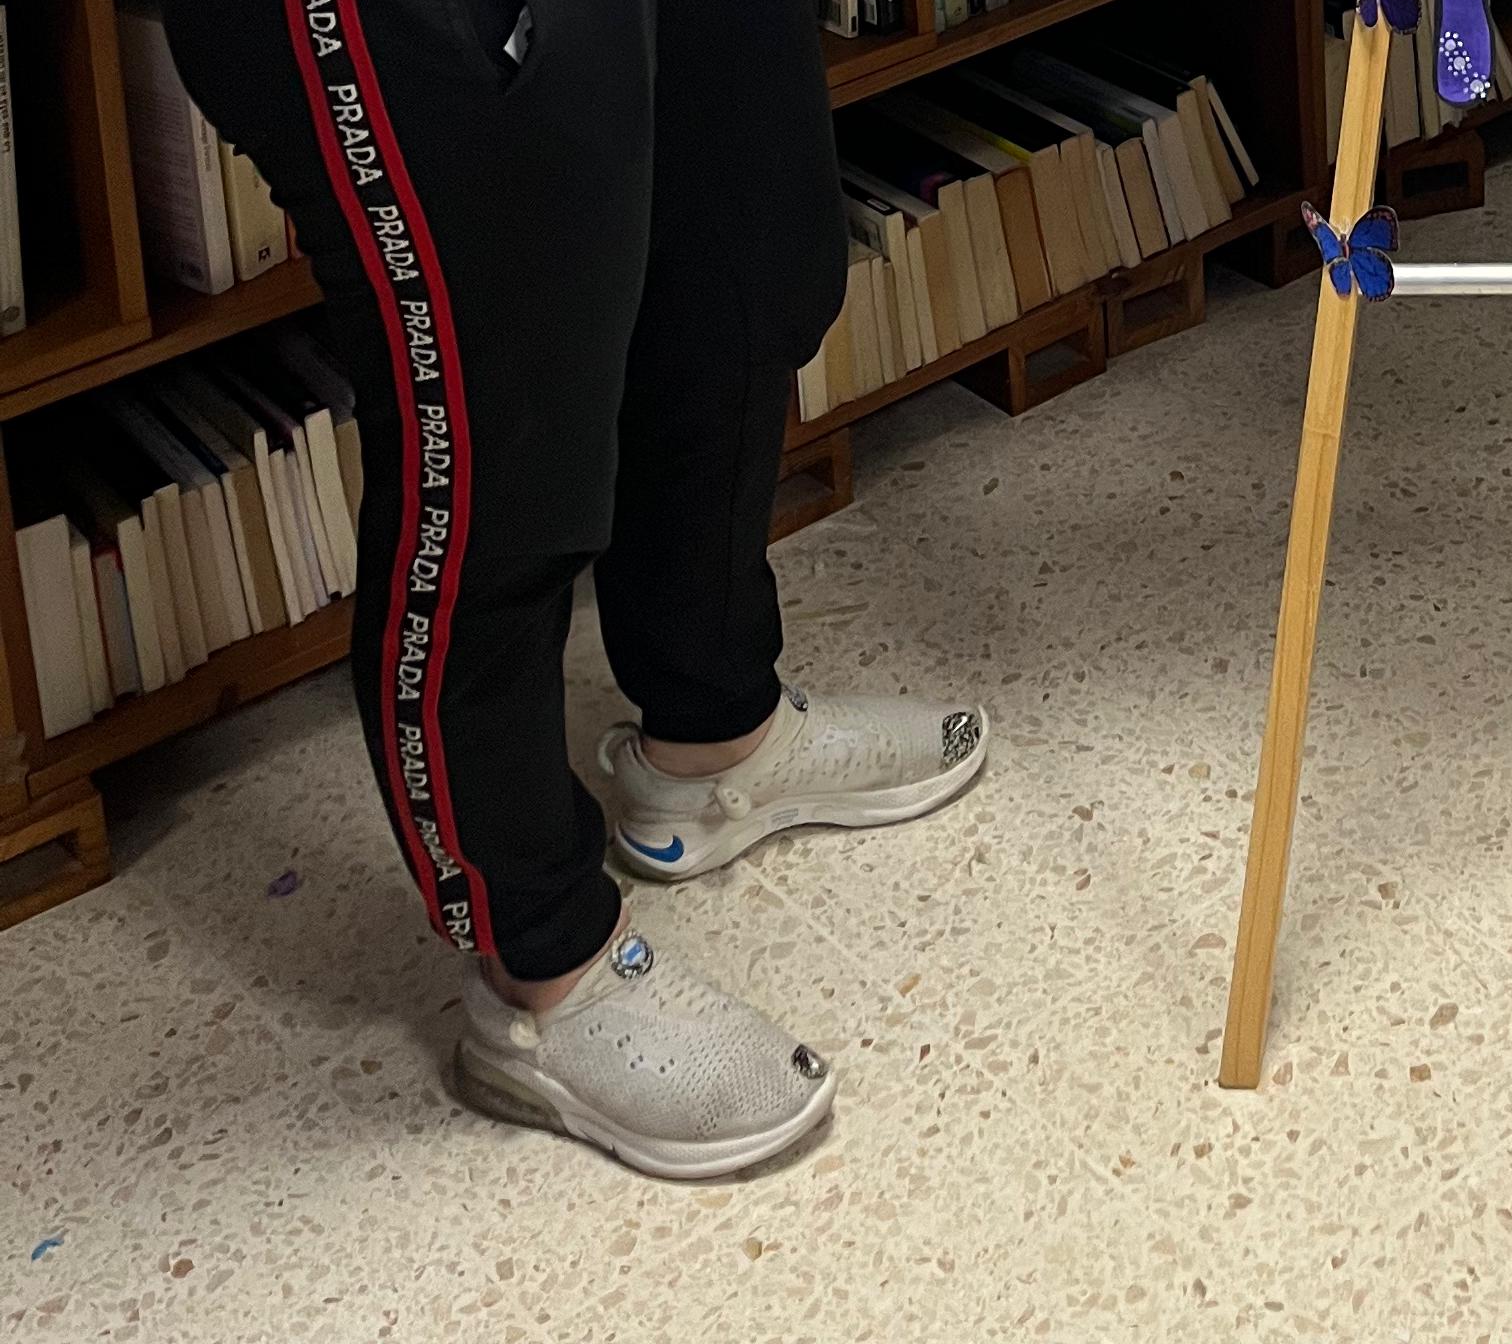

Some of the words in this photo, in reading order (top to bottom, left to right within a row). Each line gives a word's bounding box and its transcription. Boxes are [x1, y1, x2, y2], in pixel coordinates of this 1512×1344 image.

[328, 82, 384, 187] PRADA
[367, 205, 420, 283] PRADA
[400, 299, 440, 383] PRADA
[417, 403, 449, 490] PRADA
[410, 504, 450, 594] PRADA
[398, 612, 430, 702] PRADA
[398, 722, 431, 803] PRADA
[443, 900, 475, 953] PRA
